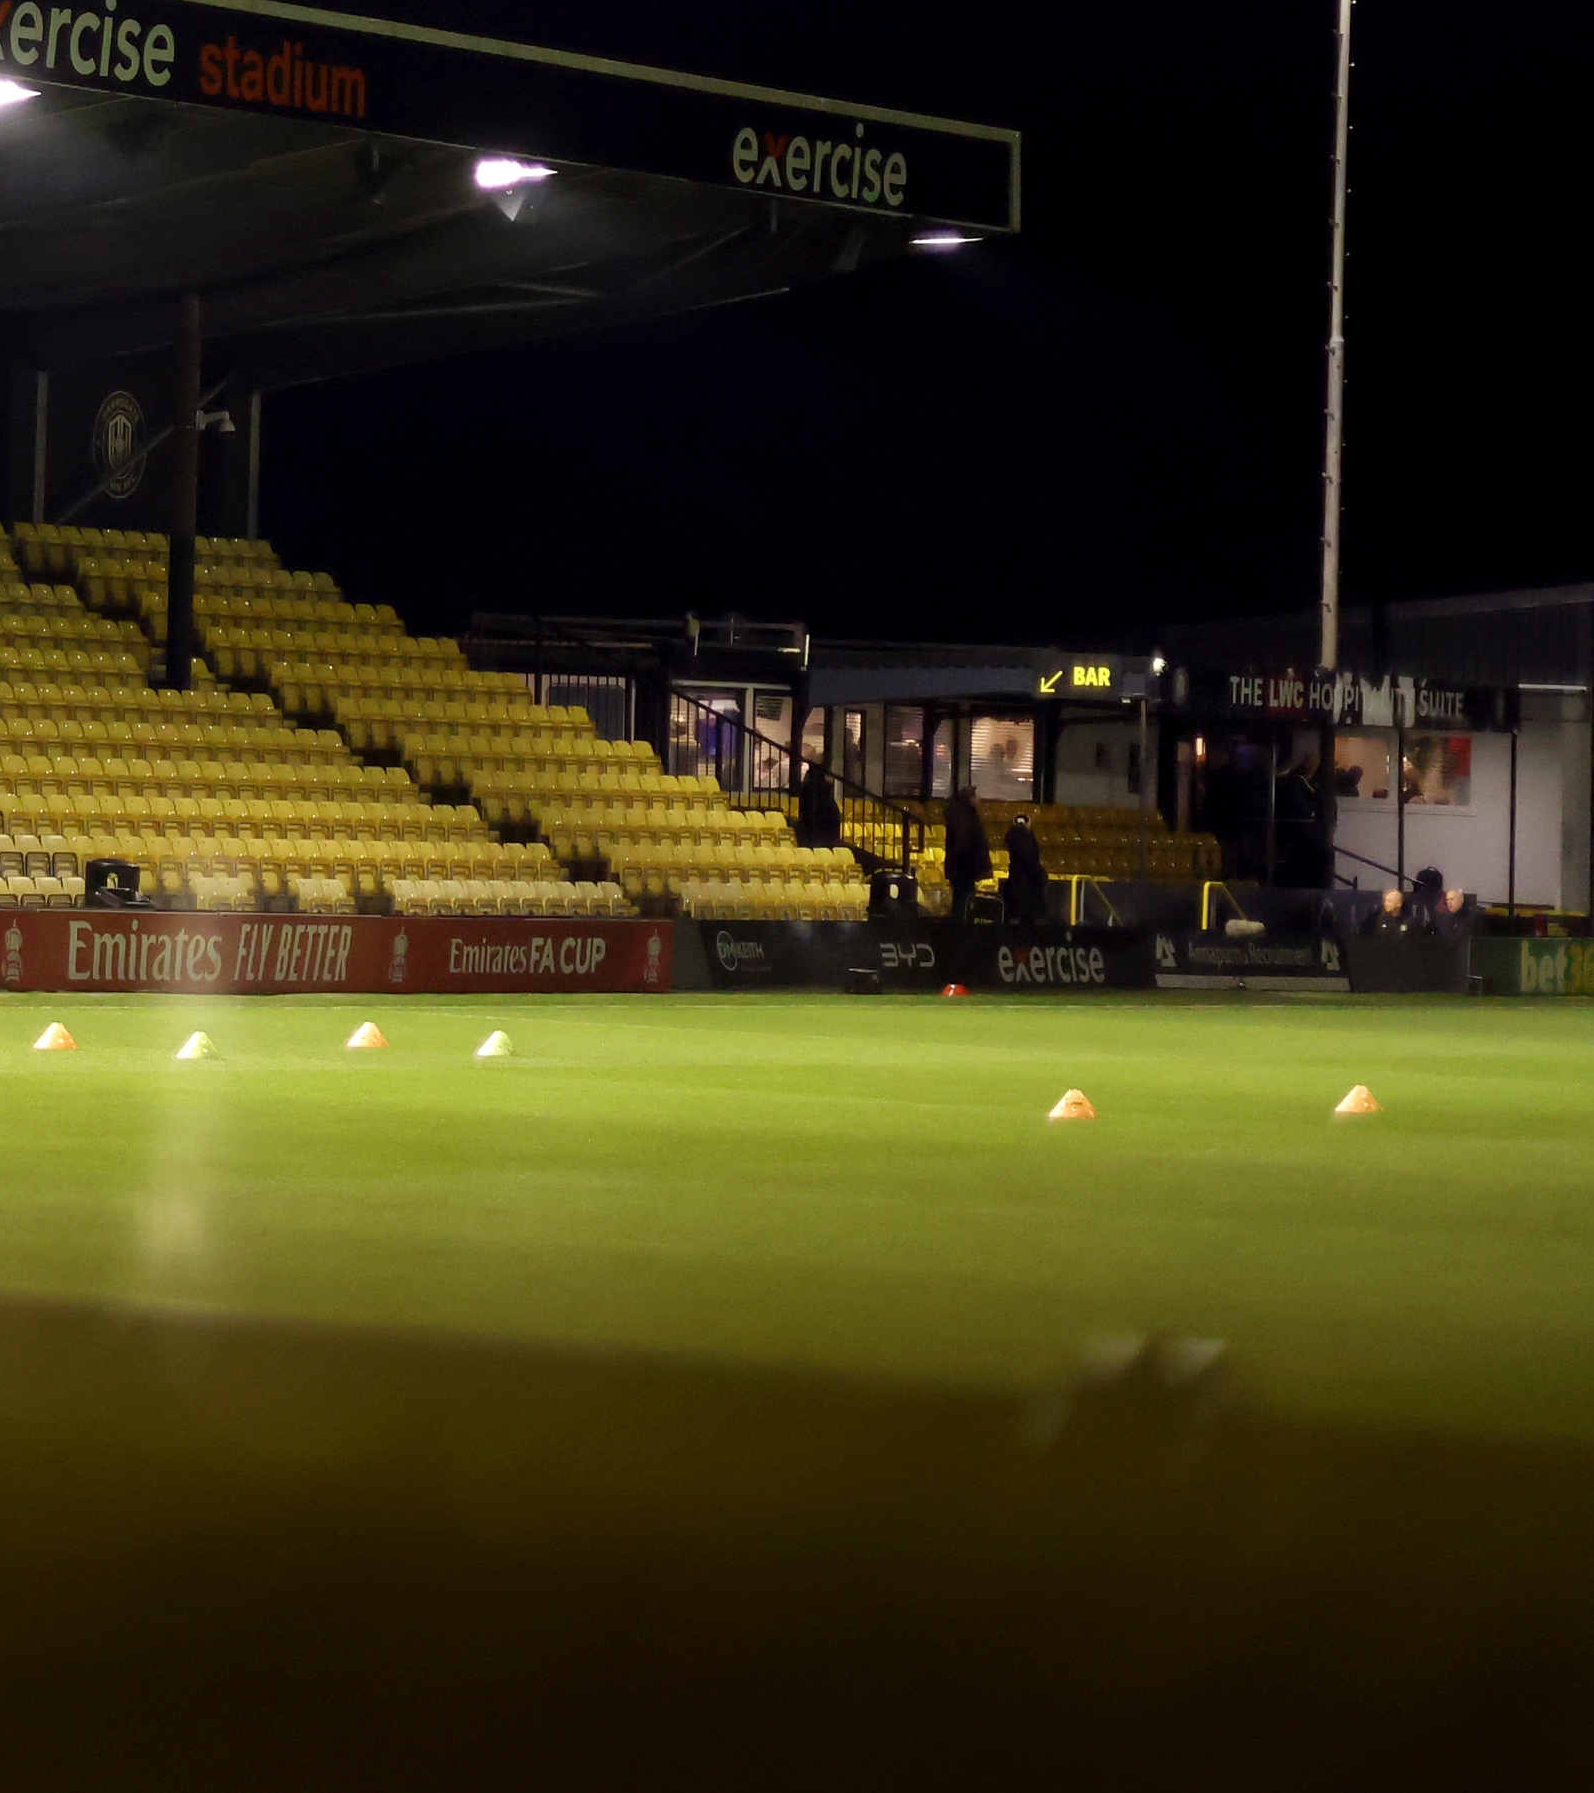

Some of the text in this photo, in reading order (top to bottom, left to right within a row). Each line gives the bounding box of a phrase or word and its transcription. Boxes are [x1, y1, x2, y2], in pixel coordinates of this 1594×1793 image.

[198, 35, 367, 118] stadium
[732, 122, 908, 206] exercise
[1073, 666, 1111, 687] BAR
[1229, 676, 1263, 706] THE
[1269, 678, 1304, 708] LWC
[1418, 689, 1465, 719] SUITE
[67, 919, 353, 982] Emirates FLY BETTER
[449, 936, 606, 975] Emirates FA CUP
[879, 942, 935, 969] BYD
[997, 930, 1106, 984] exercise
